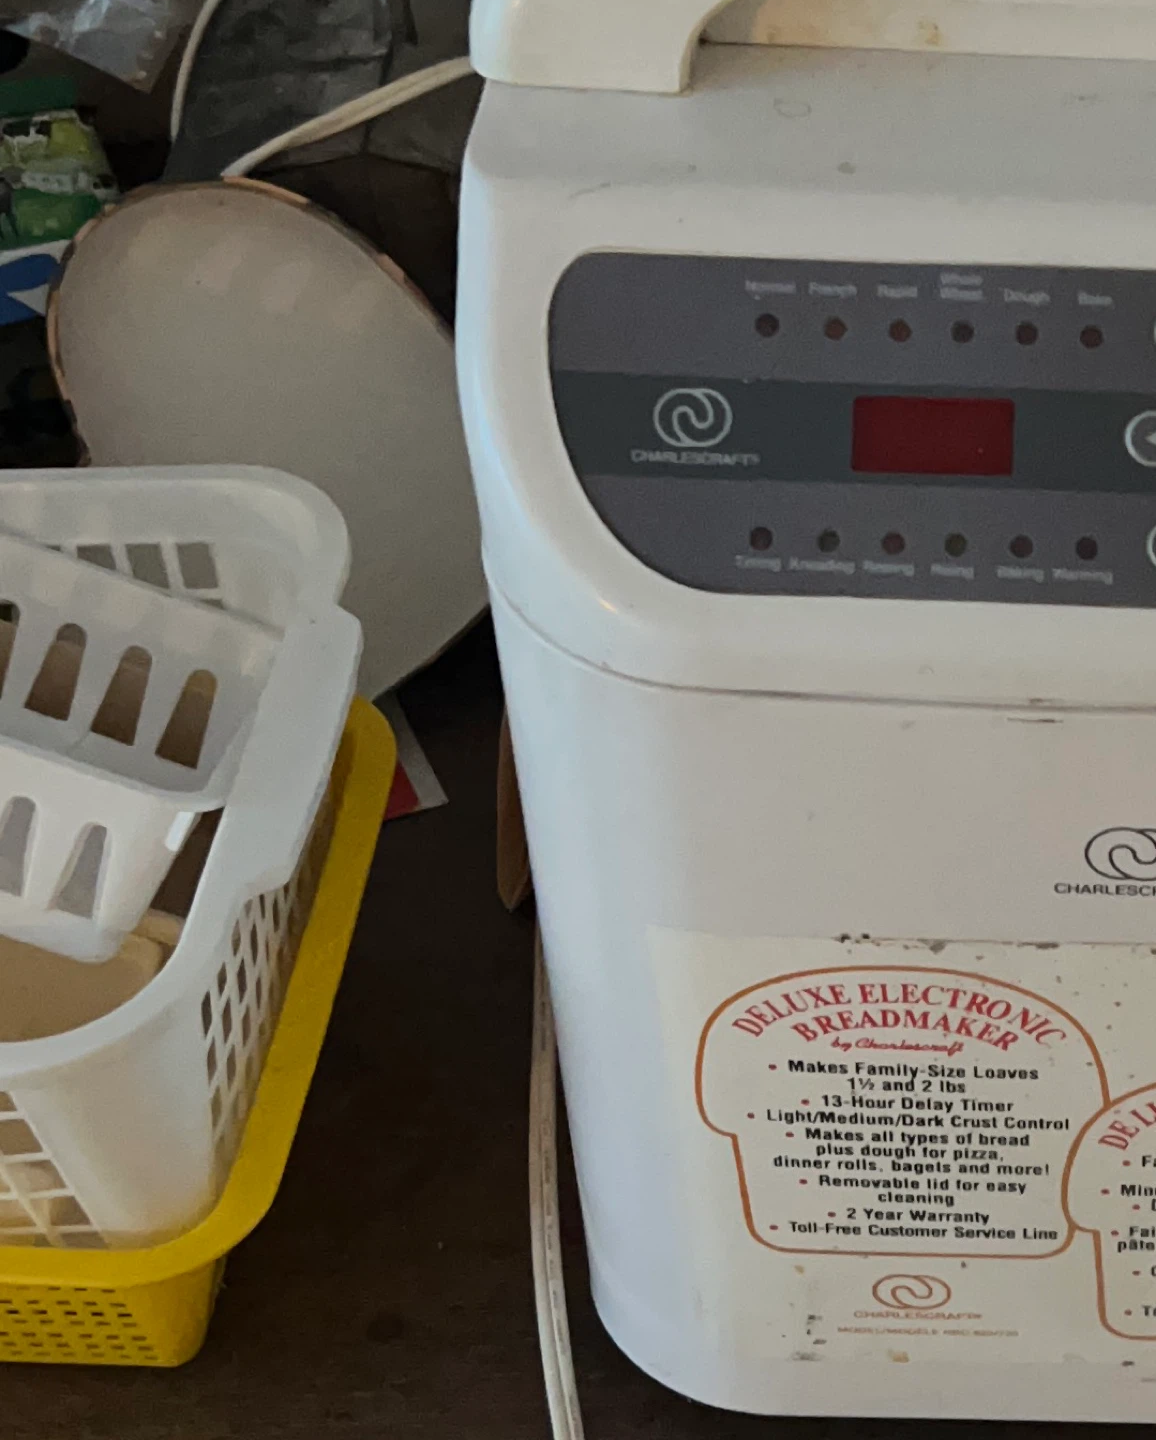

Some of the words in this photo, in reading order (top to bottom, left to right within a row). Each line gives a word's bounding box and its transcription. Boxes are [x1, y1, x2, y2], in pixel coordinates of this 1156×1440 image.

[732, 984, 851, 1037] DELUXE
[858, 983, 1066, 1046] ELECTRONIC
[790, 1009, 1019, 1051] BREADMAKER
[831, 1037, 852, 1052] by
[788, 1059, 848, 1073] Makes
[856, 1062, 966, 1079] Family-Size
[974, 1066, 1039, 1080] Loaves
[882, 1078, 915, 1092] and
[922, 1080, 932, 1092] 2
[940, 1080, 966, 1093] lbs
[822, 1094, 895, 1108] 13-Hour
[902, 1097, 954, 1113] Delay
[962, 1098, 1014, 1112] Timer
[767, 1109, 944, 1127] Light/Medium/Dark
[951, 1115, 998, 1128] Crust
[1004, 1116, 1069, 1130] Control
[805, 1127, 864, 1141] Makes
[871, 1130, 894, 1142] all
[901, 1132, 949, 1146] types
[956, 1132, 972, 1145] of
[979, 1134, 1030, 1146] bread
[816, 1143, 854, 1156] plus
[861, 1144, 915, 1160] dough
[923, 1146, 946, 1159] for
[953, 1148, 1004, 1162] pizza,
[773, 1155, 830, 1169] dinner
[891, 1160, 951, 1175] bagels
[959, 1163, 990, 1175] and
[997, 1164, 1049, 1176] more!
[819, 1175, 920, 1189] Removable
[927, 1178, 949, 1191] lid
[956, 1179, 979, 1191] for
[986, 1182, 1027, 1195] easy
[878, 1191, 954, 1207] cleaning
[847, 1208, 856, 1220] 2
[863, 1208, 903, 1221] Year
[909, 1209, 989, 1225] Warranty
[789, 1221, 861, 1235] Toll-Free
[869, 1224, 947, 1238] Customer
[954, 1226, 1016, 1239] Service
[1023, 1228, 1058, 1240] Line
